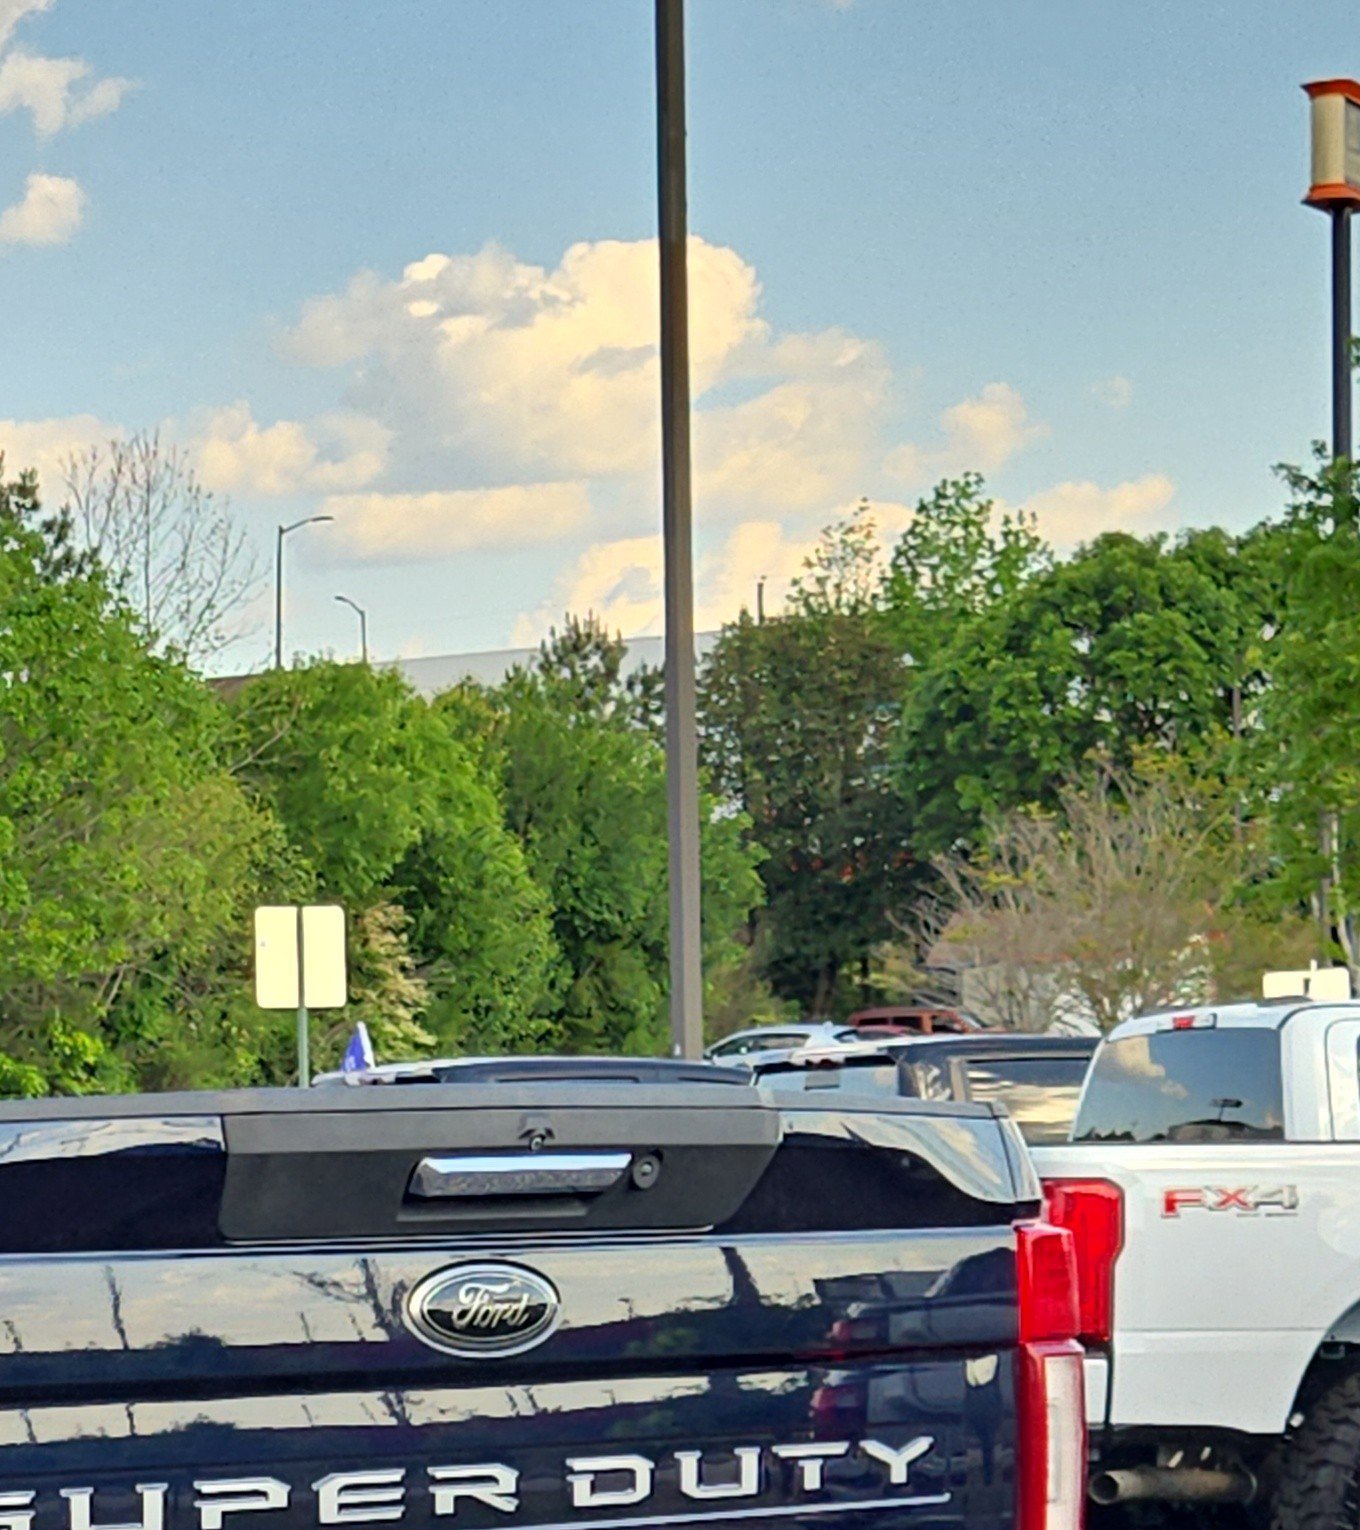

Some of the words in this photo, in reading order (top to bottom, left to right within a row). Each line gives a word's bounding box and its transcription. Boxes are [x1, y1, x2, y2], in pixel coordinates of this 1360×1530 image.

[1161, 1184, 1299, 1214] FX4
[451, 1281, 529, 1330] Ford
[566, 1436, 934, 1510] DUTY
